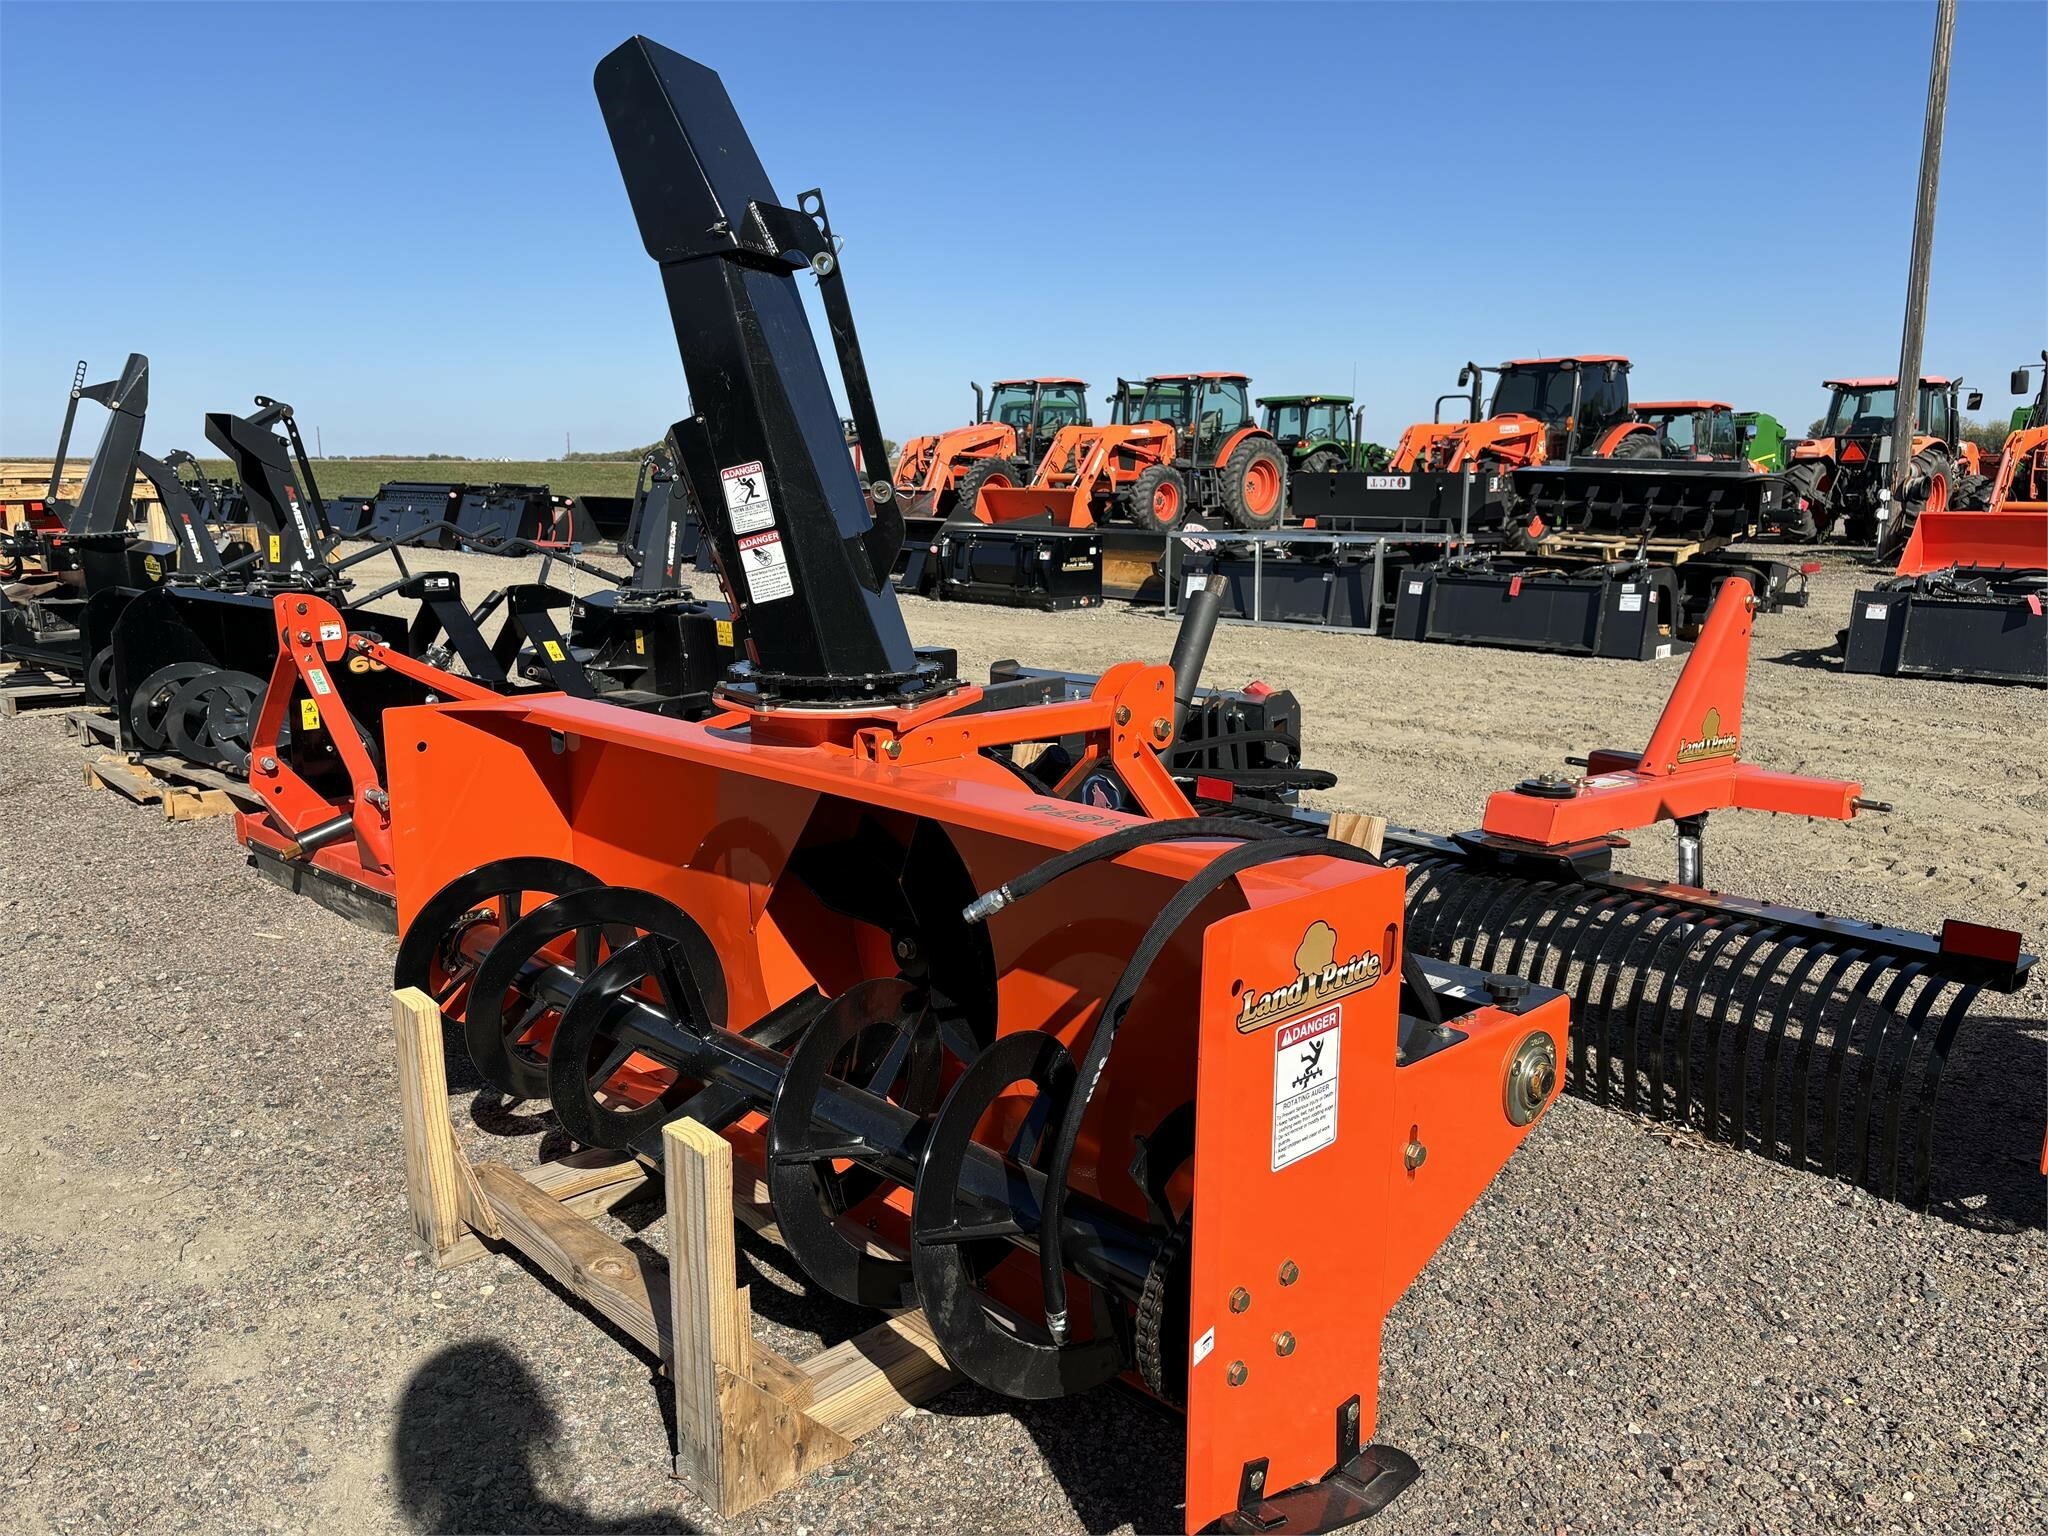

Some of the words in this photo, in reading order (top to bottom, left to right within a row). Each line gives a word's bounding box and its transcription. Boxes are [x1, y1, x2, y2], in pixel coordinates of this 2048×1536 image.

[728, 464, 761, 479] DANGER
[1370, 478, 1395, 488] JCT
[185, 523, 204, 564] METEOR
[290, 501, 314, 561] METEOR
[667, 521, 678, 565] METEOR
[745, 532, 780, 548] DANGER
[1678, 736, 1707, 760] Land
[1711, 732, 1737, 754] Pride
[1239, 972, 1305, 1024] Land
[1317, 951, 1381, 995] Pride
[1292, 1012, 1337, 1041] DANGER
[1283, 1093, 1310, 1109] ROTATING
[1311, 1084, 1329, 1097] AUGER
